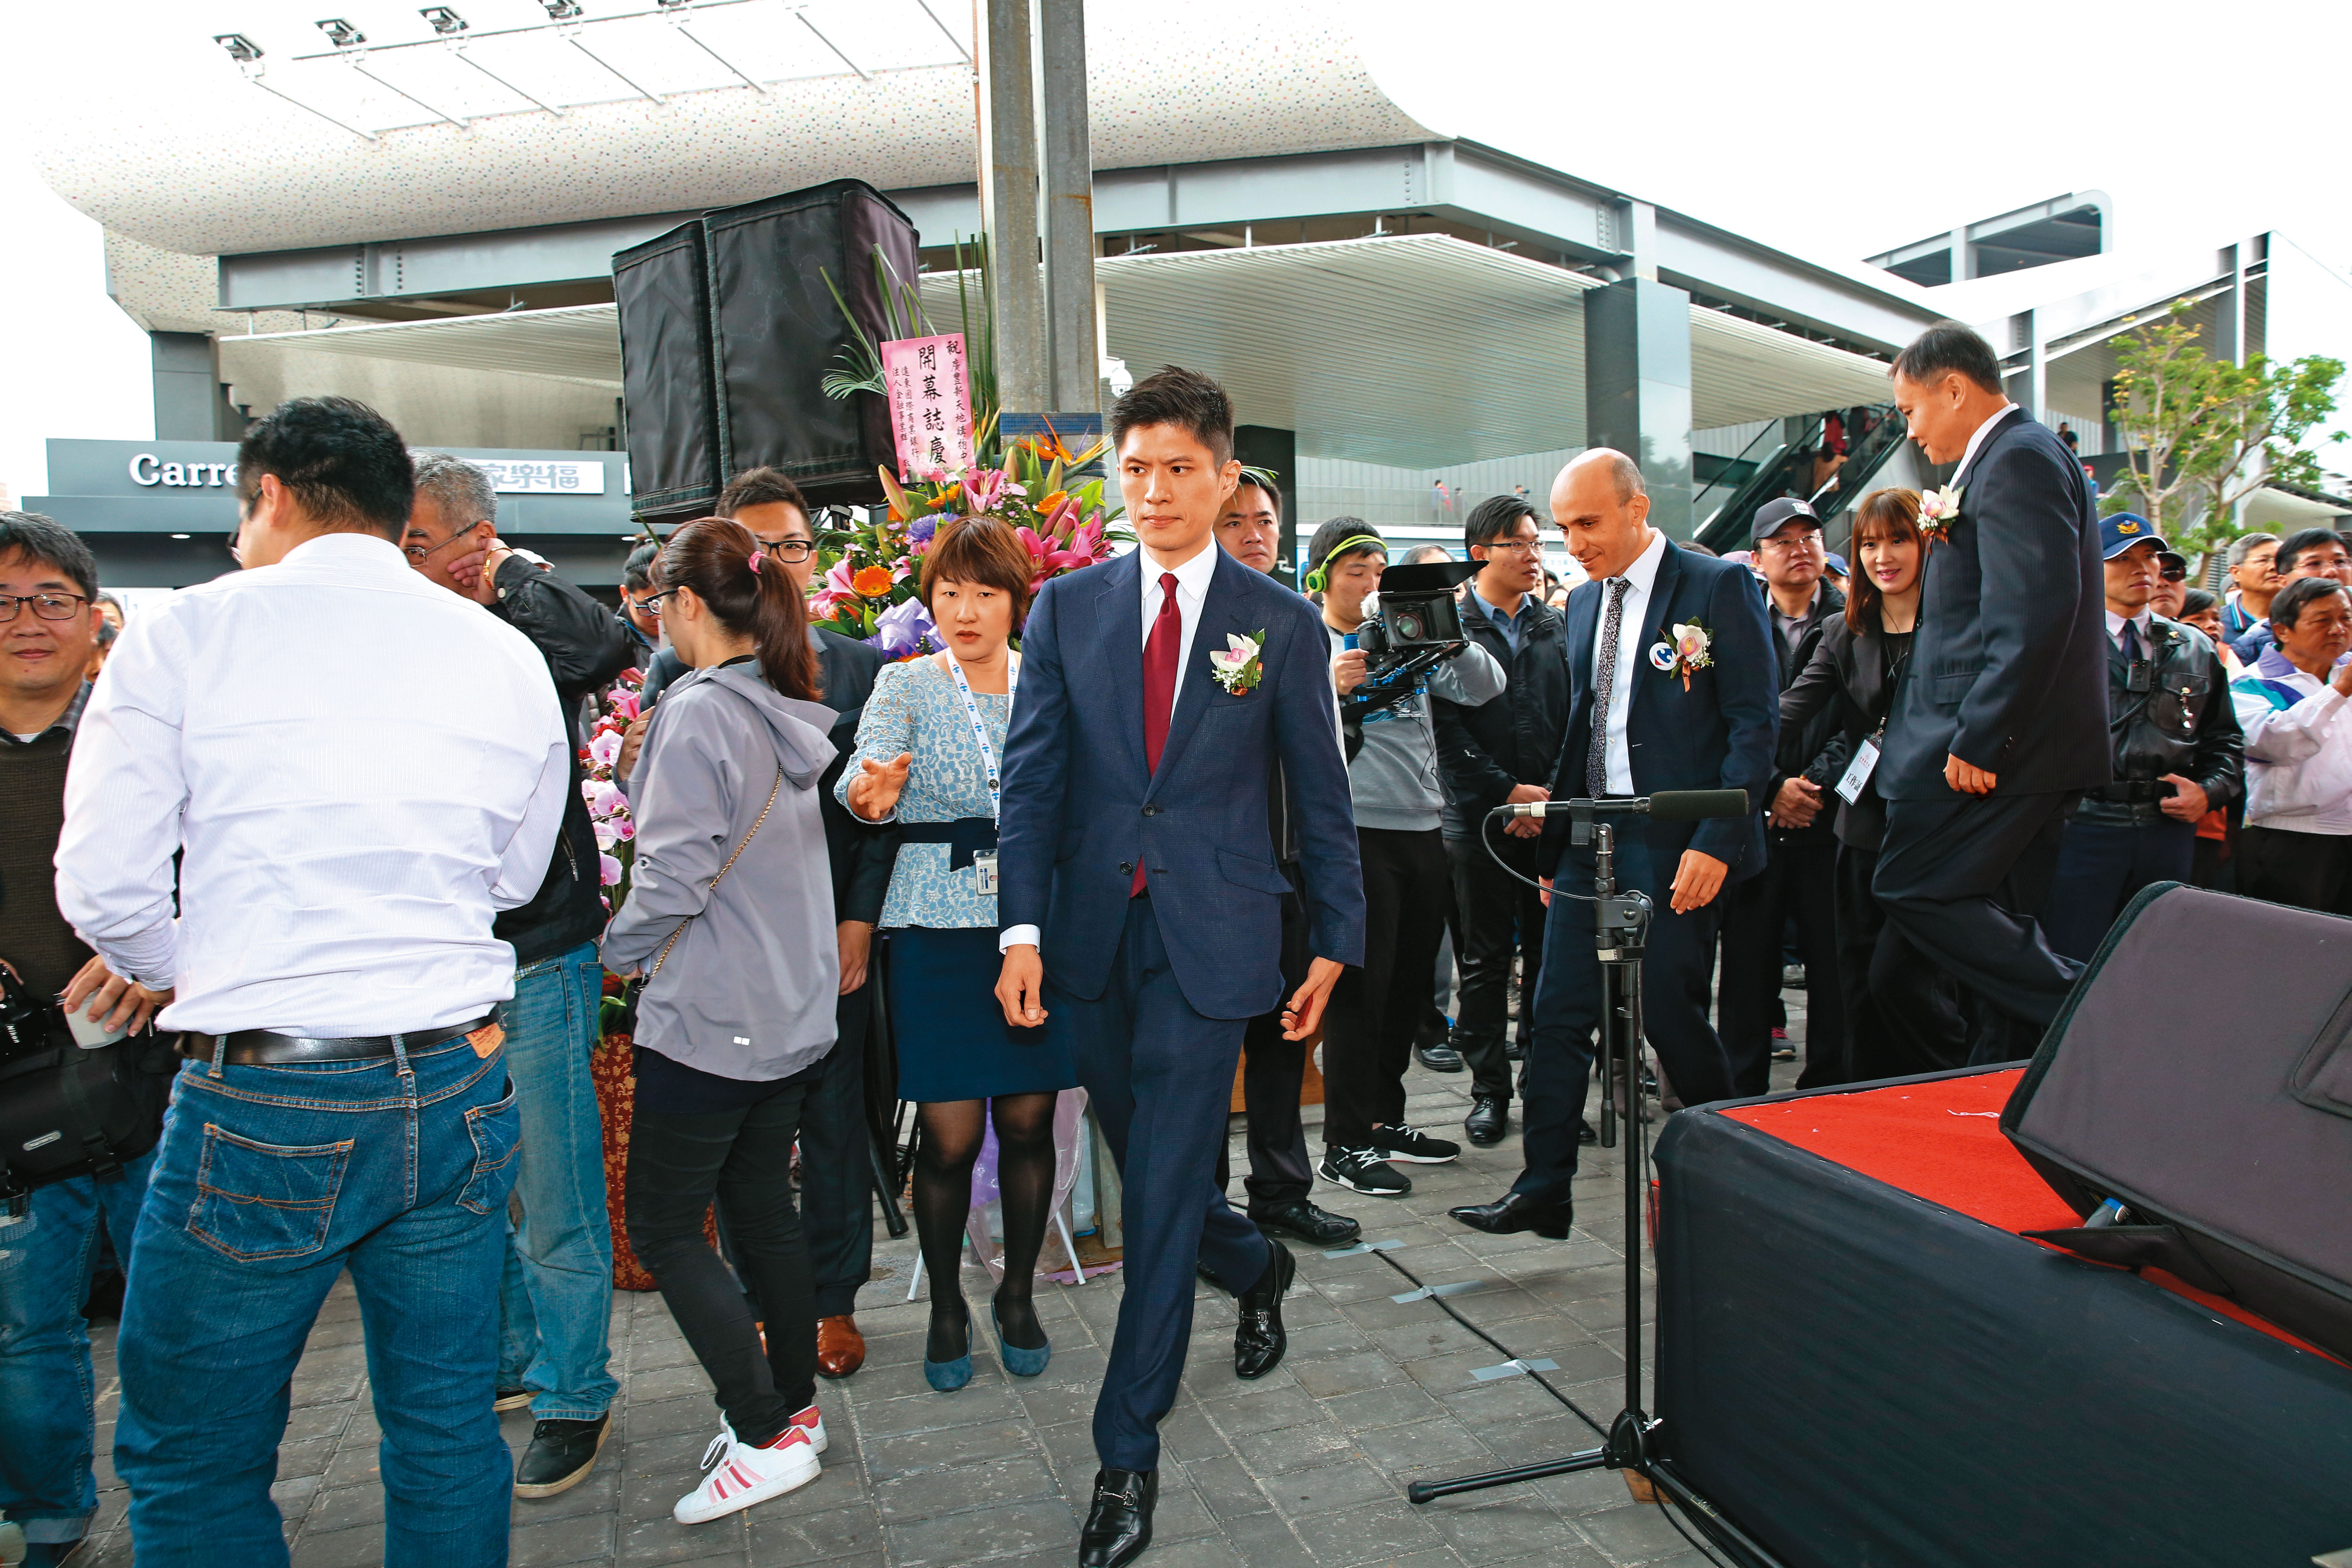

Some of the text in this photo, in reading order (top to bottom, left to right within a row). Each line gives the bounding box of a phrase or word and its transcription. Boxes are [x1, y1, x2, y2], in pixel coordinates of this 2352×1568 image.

[918, 344, 947, 464] 開幕誌慶
[7, 1025, 20, 1043] Nikon
